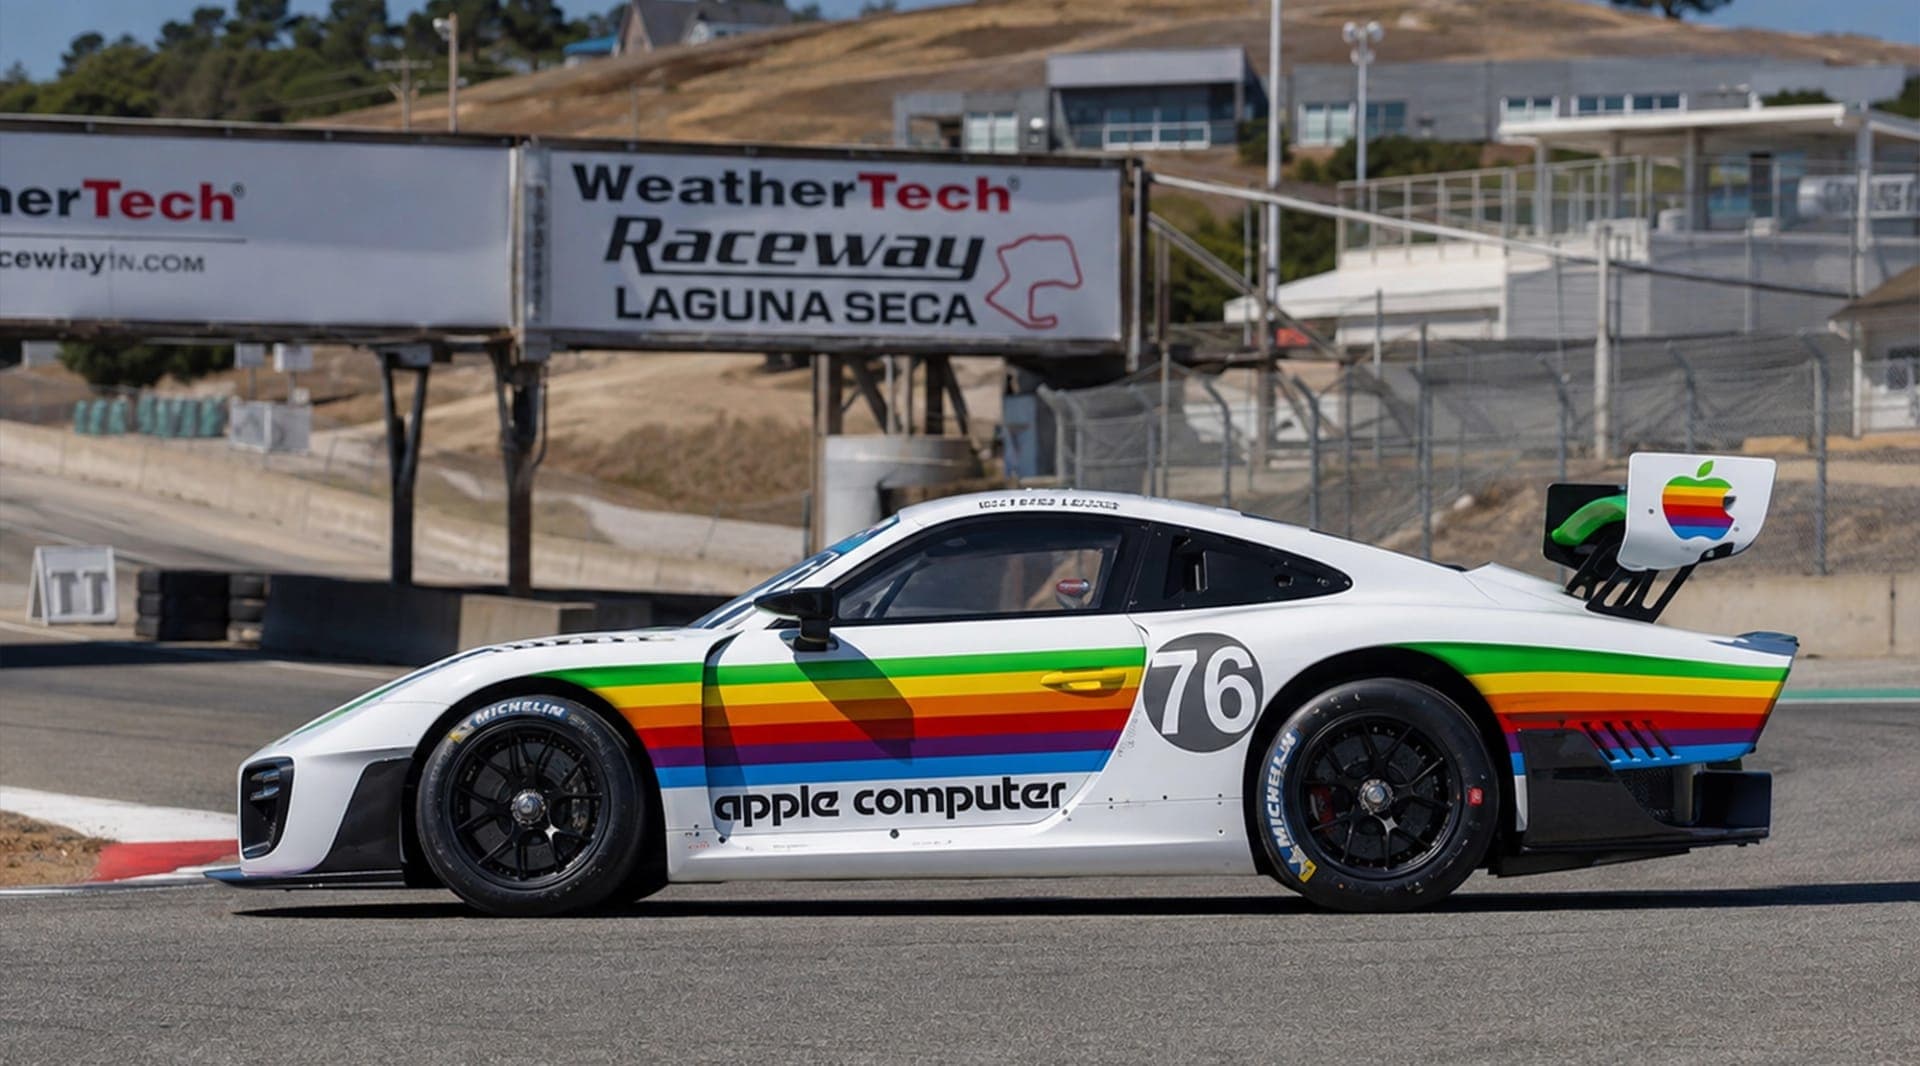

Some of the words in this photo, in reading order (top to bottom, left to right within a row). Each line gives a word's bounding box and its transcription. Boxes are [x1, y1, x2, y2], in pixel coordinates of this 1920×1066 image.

[573, 164, 1011, 212] WeatherTech
[604, 216, 985, 281] Raceway
[616, 287, 832, 323] LAGUNA
[845, 293, 977, 326] SECA
[475, 701, 565, 725] MICHELIN
[1152, 645, 1257, 734] 76
[714, 785, 840, 827] apple
[853, 776, 1067, 820] computer
